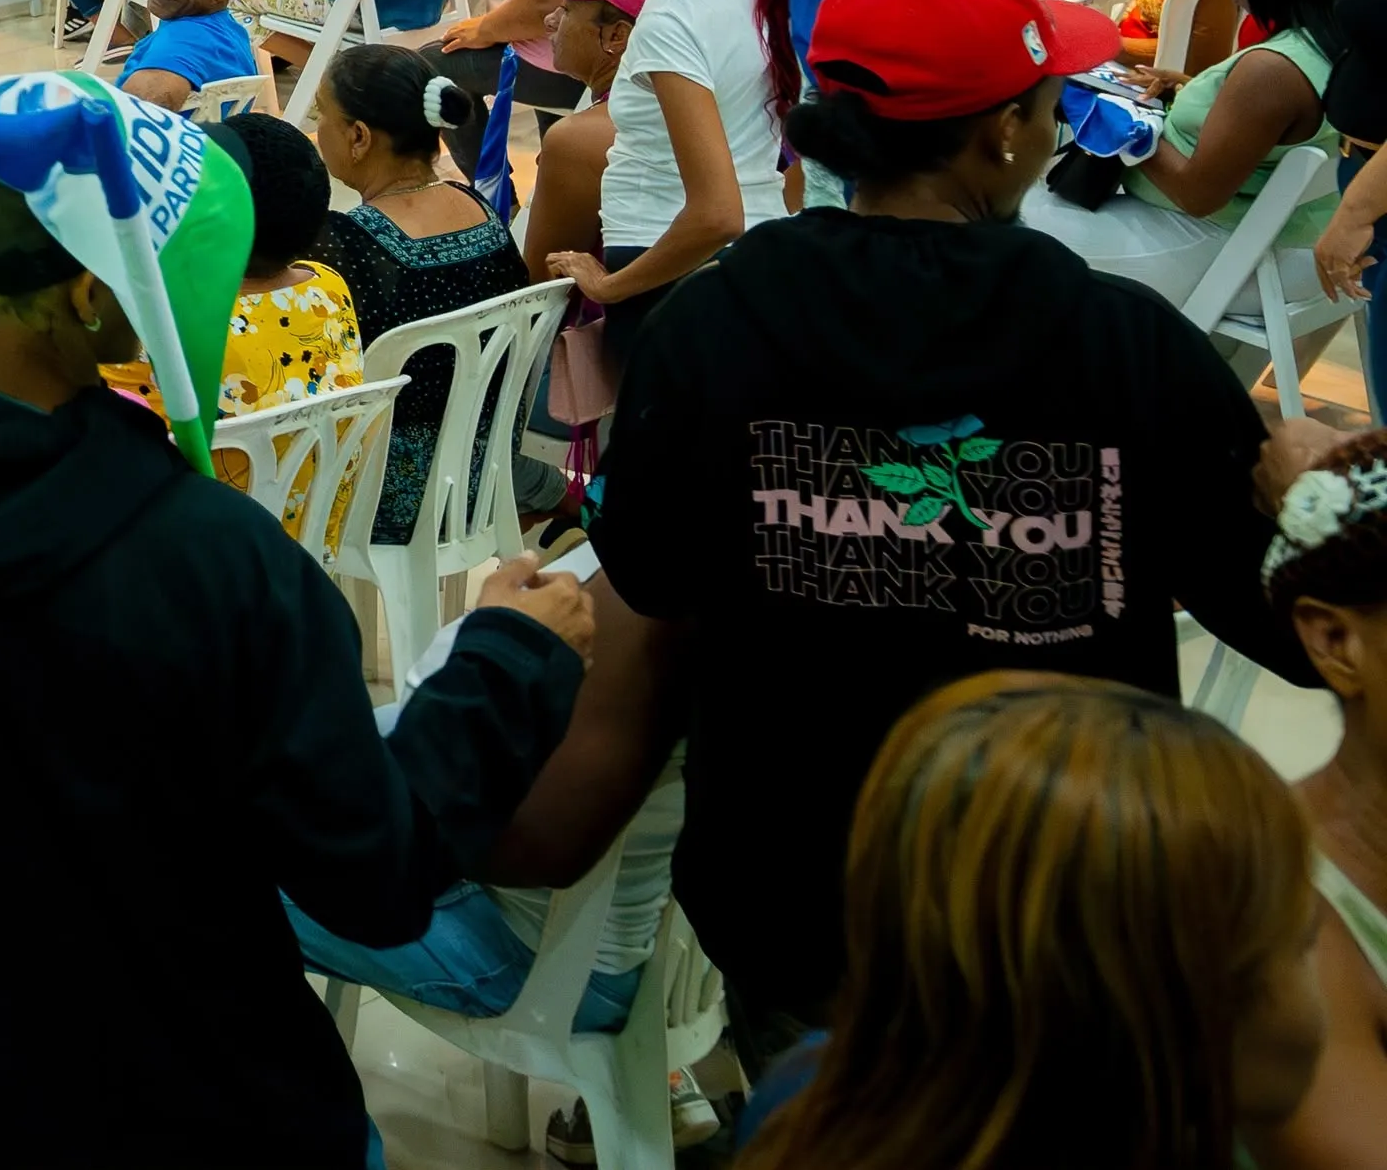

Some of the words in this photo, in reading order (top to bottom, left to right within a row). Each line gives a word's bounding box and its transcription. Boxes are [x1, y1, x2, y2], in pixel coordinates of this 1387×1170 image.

[752, 489, 955, 544] THANK
[970, 507, 1093, 554] YOU
[754, 522, 958, 580] THANK
[967, 541, 1093, 588] YOU
[755, 555, 958, 612] THANK
[968, 577, 1096, 624] YOU
[967, 622, 1010, 643] FOR
[1013, 624, 1094, 645] NOTHING
